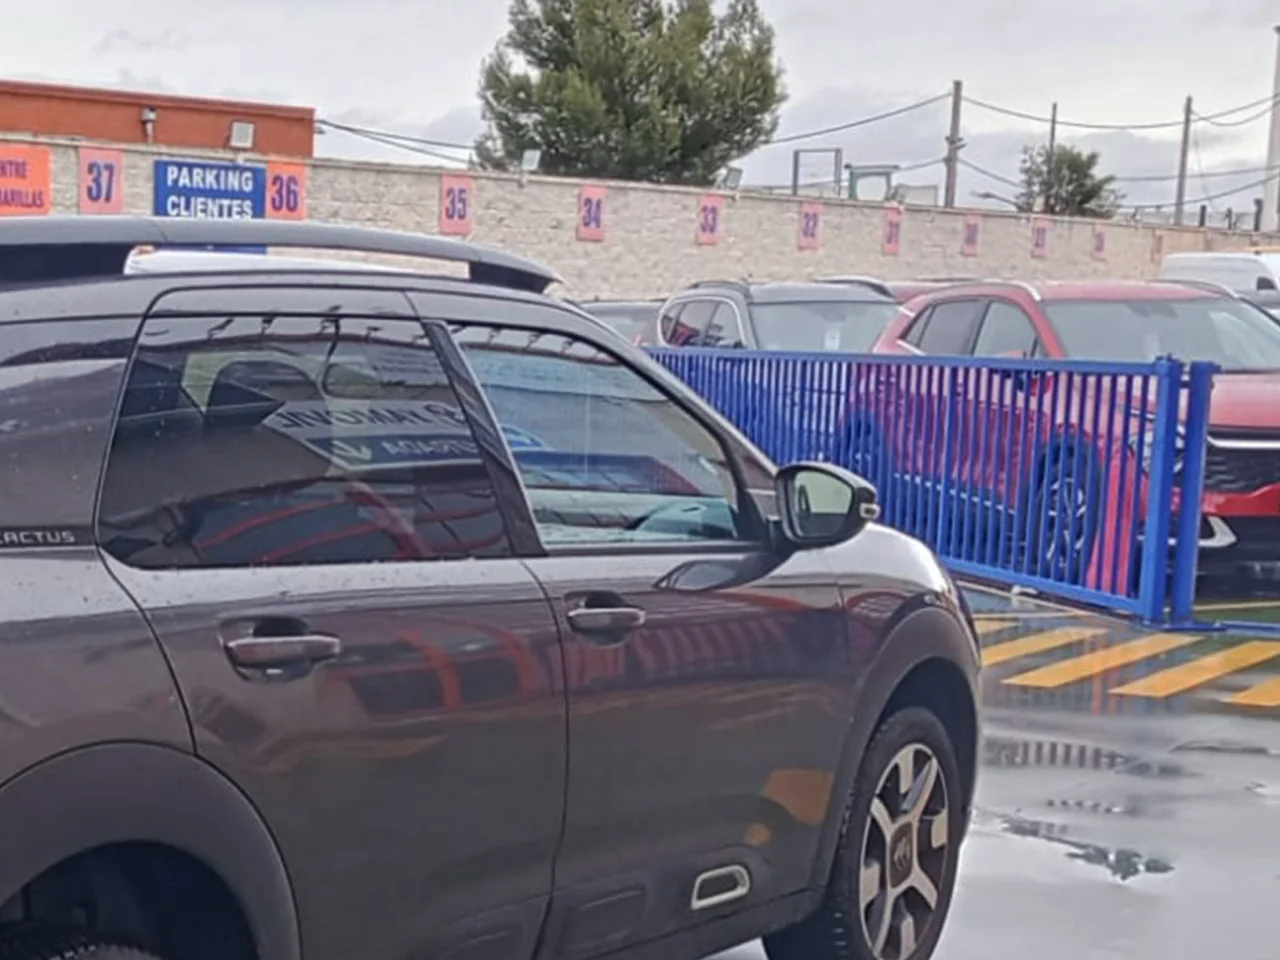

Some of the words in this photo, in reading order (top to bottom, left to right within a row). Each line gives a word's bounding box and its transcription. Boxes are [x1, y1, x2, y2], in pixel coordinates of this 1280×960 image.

[86, 161, 114, 204] 37
[166, 165, 254, 192] PARKING
[271, 174, 299, 213] 36
[166, 195, 254, 219] CLIENTES
[445, 187, 467, 220] 35
[582, 197, 602, 229] 34
[700, 205, 718, 233] 33
